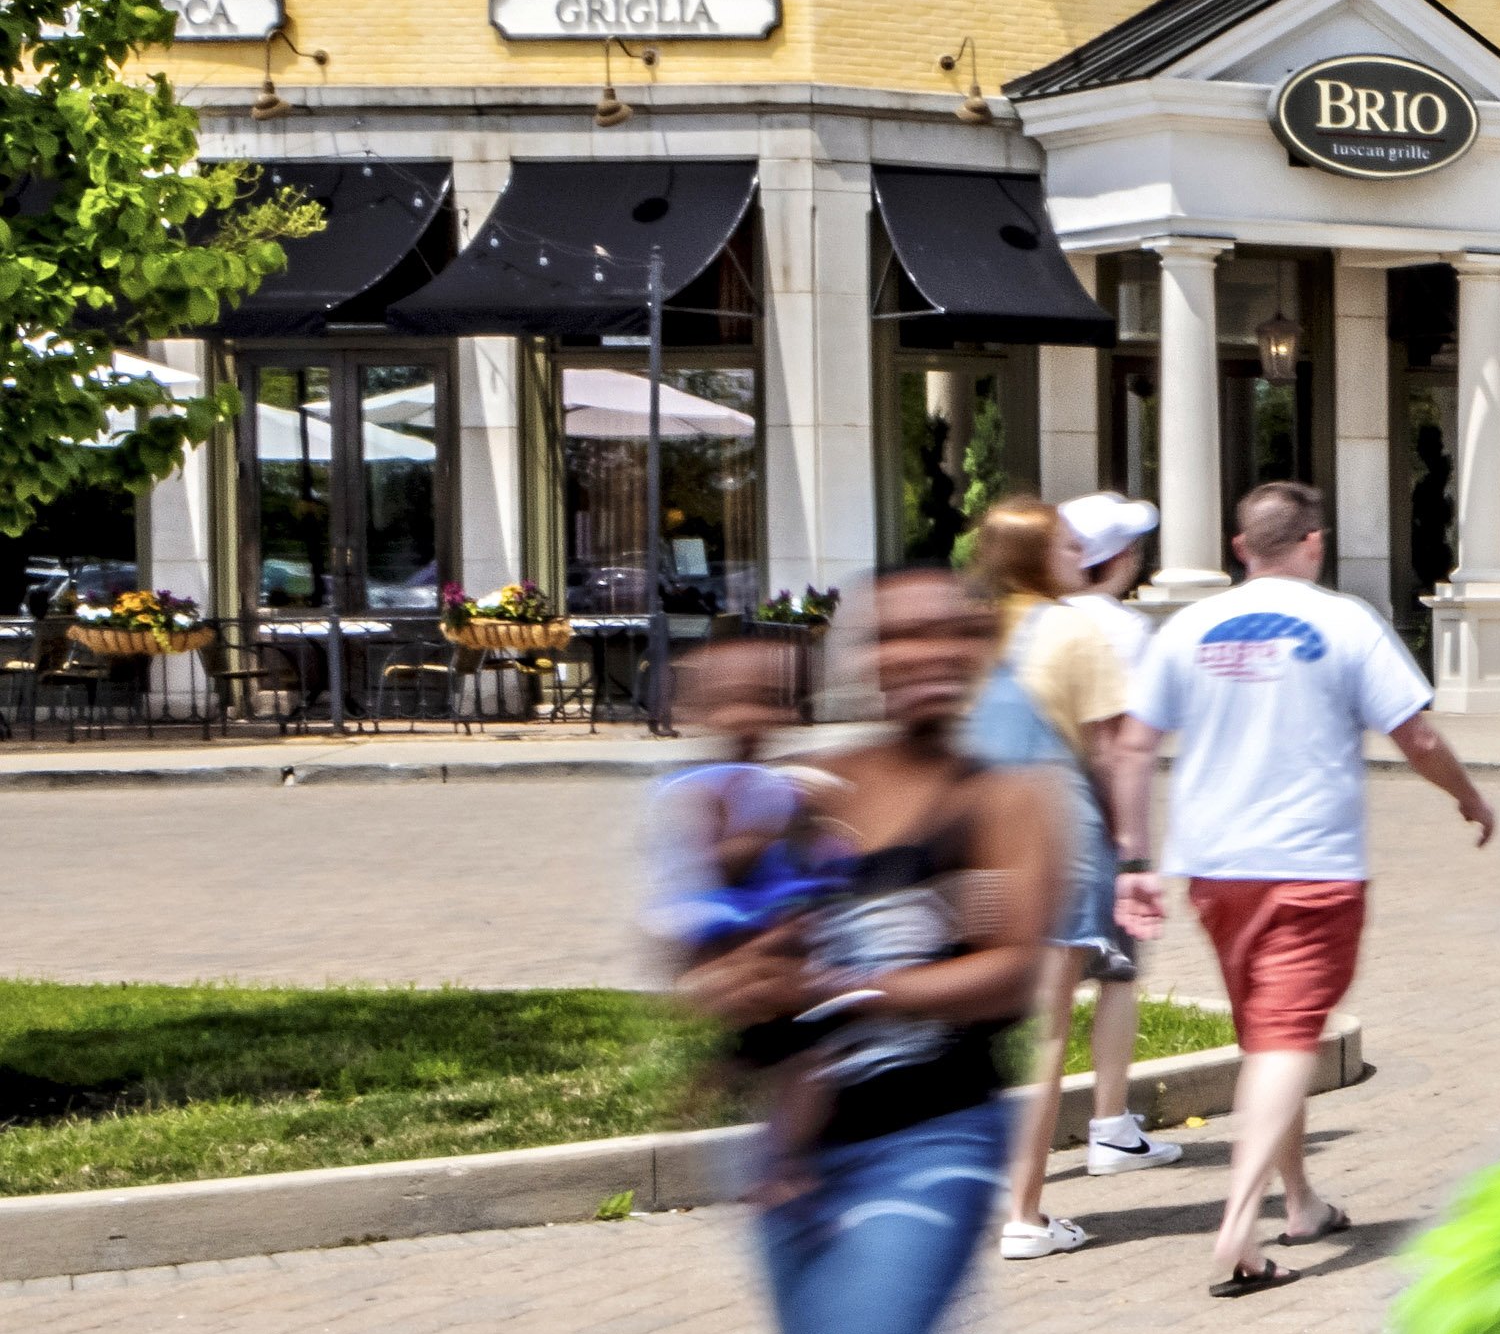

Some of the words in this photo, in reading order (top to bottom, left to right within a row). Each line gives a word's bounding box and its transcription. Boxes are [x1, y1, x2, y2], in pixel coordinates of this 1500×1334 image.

[1314, 79, 1447, 135] BRIO
[1332, 142, 1385, 158] tuscan
[1388, 144, 1431, 162] grille
